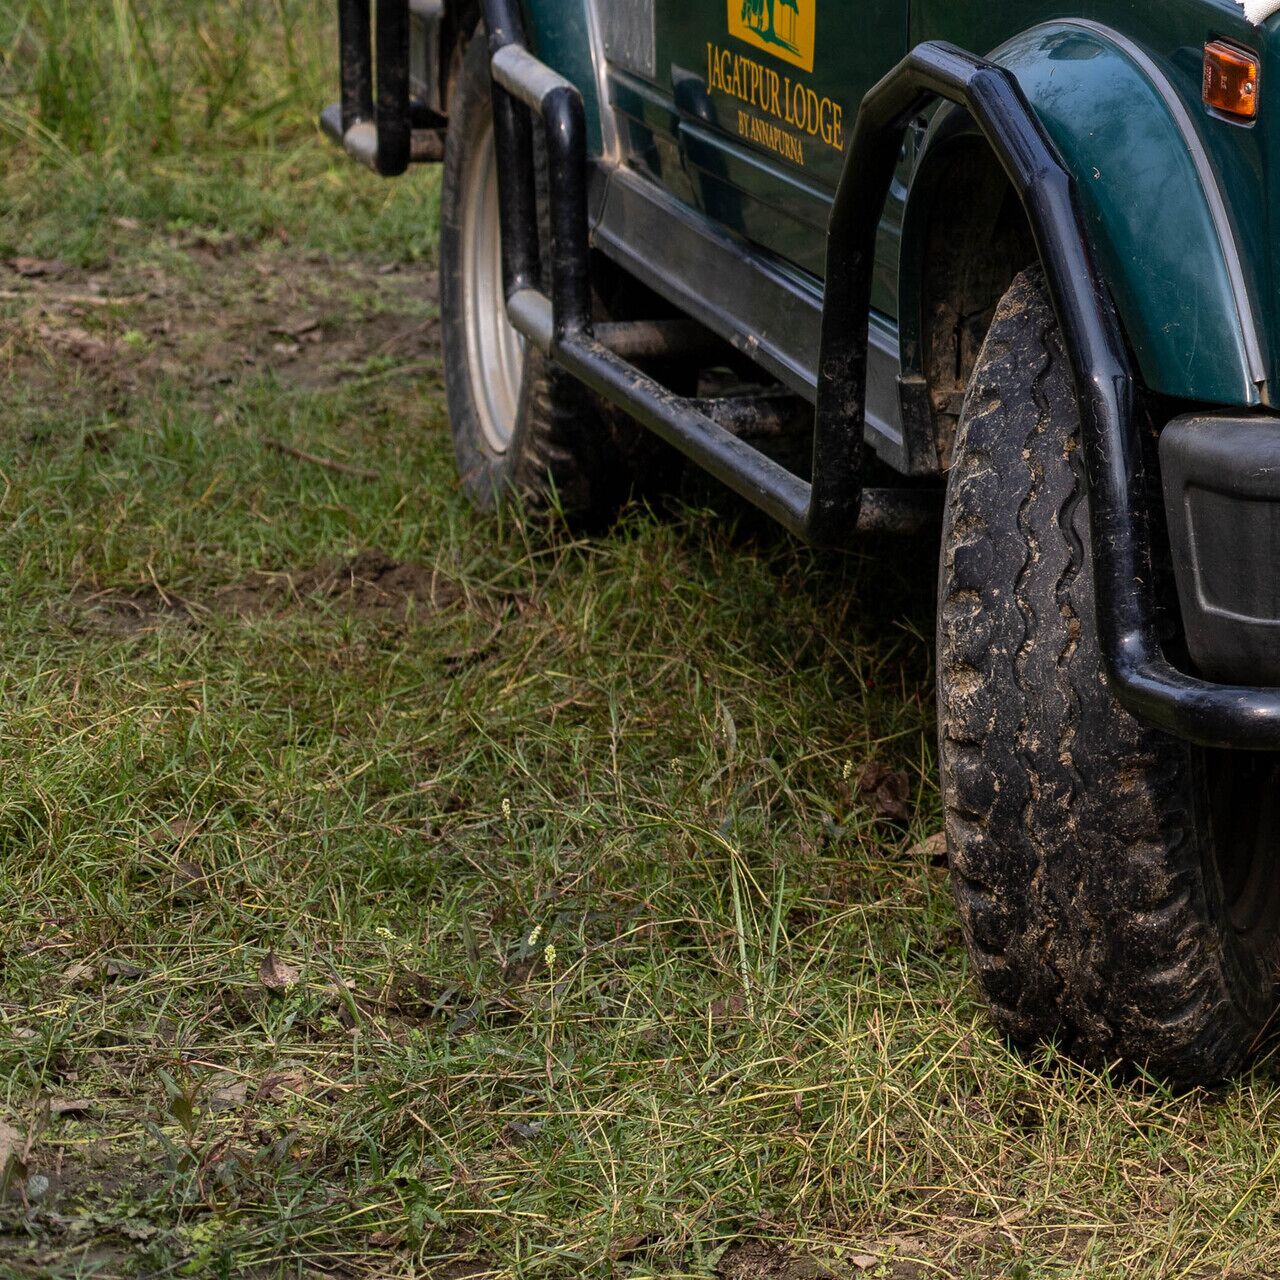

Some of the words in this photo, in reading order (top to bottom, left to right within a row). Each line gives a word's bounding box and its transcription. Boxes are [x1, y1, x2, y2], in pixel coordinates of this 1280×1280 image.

[707, 41, 782, 119] JAGATPUR
[784, 77, 843, 151] LODGE
[738, 110, 749, 138] BY
[751, 115, 804, 166] ANNAPURNA
